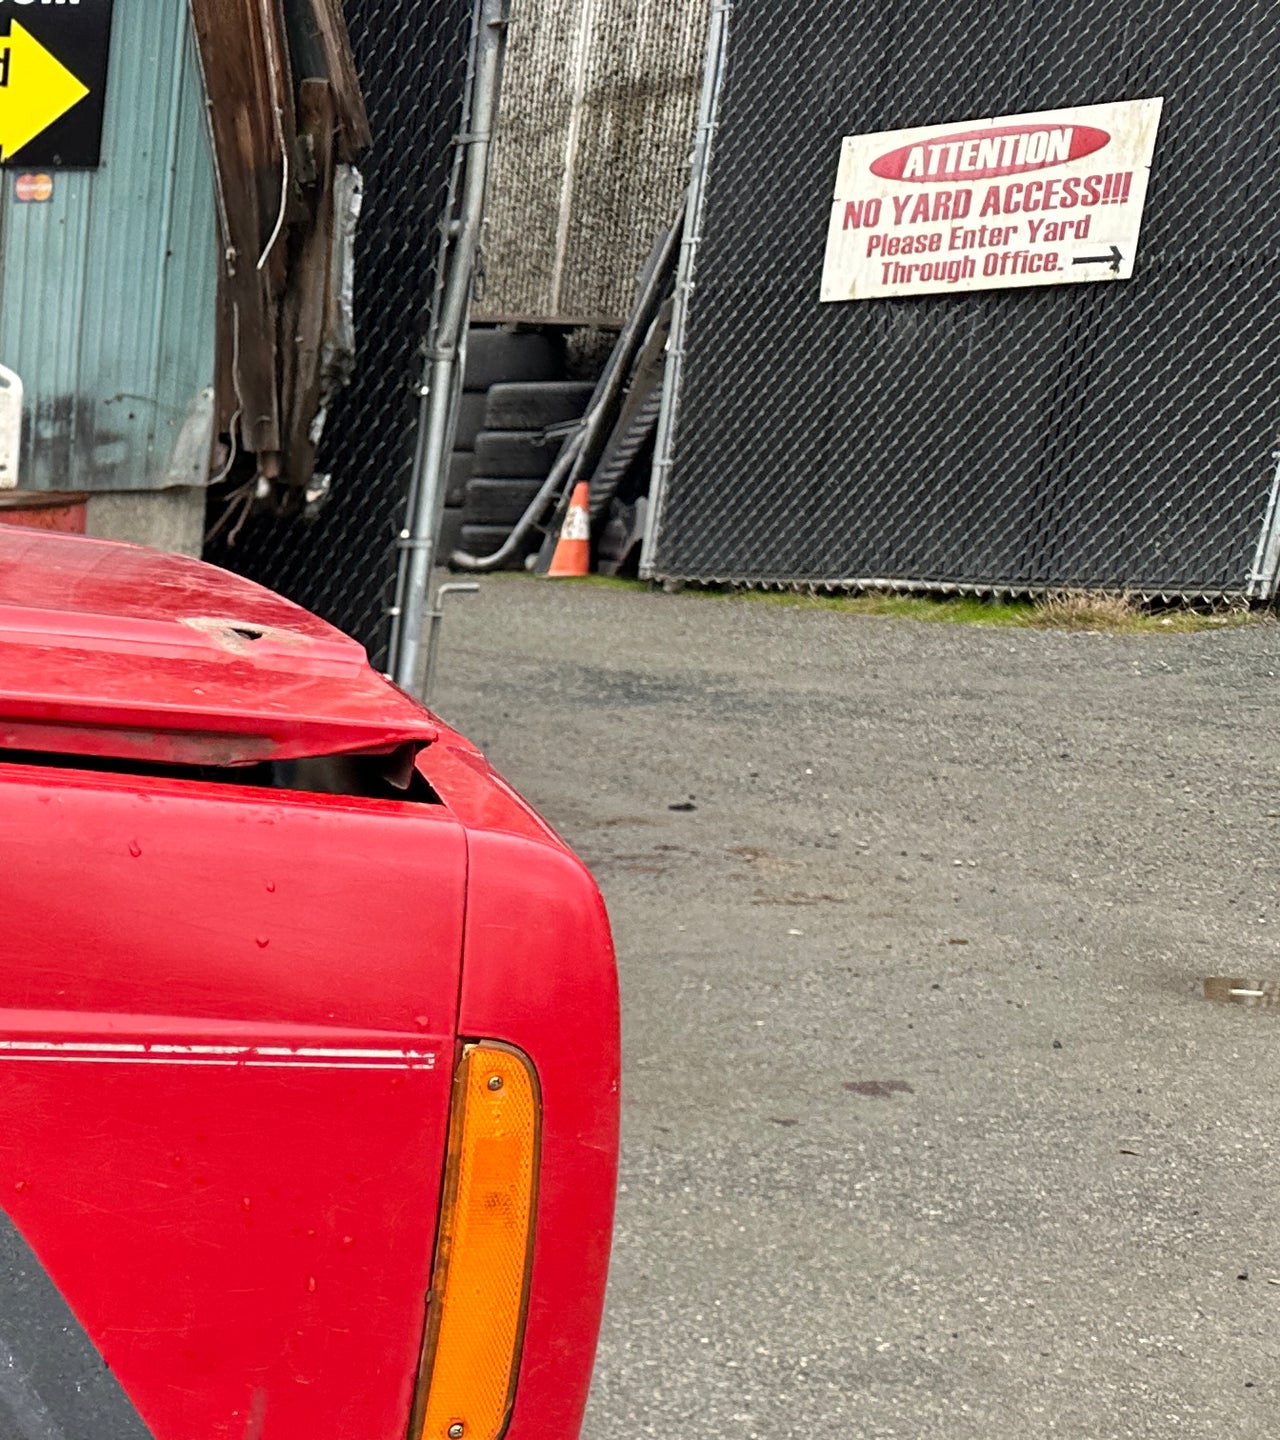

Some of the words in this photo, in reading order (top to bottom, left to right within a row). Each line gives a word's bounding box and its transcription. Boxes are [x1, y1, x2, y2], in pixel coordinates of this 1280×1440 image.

[902, 127, 1074, 178] ATTENTION
[842, 198, 883, 231] NO
[892, 188, 972, 225] YARD
[979, 171, 1133, 217] ACCESS!!!
[866, 229, 943, 257] Please
[948, 222, 1018, 249] Enter
[1027, 214, 1092, 242] Yard
[880, 256, 976, 286] Through
[982, 249, 1065, 278] Office.
